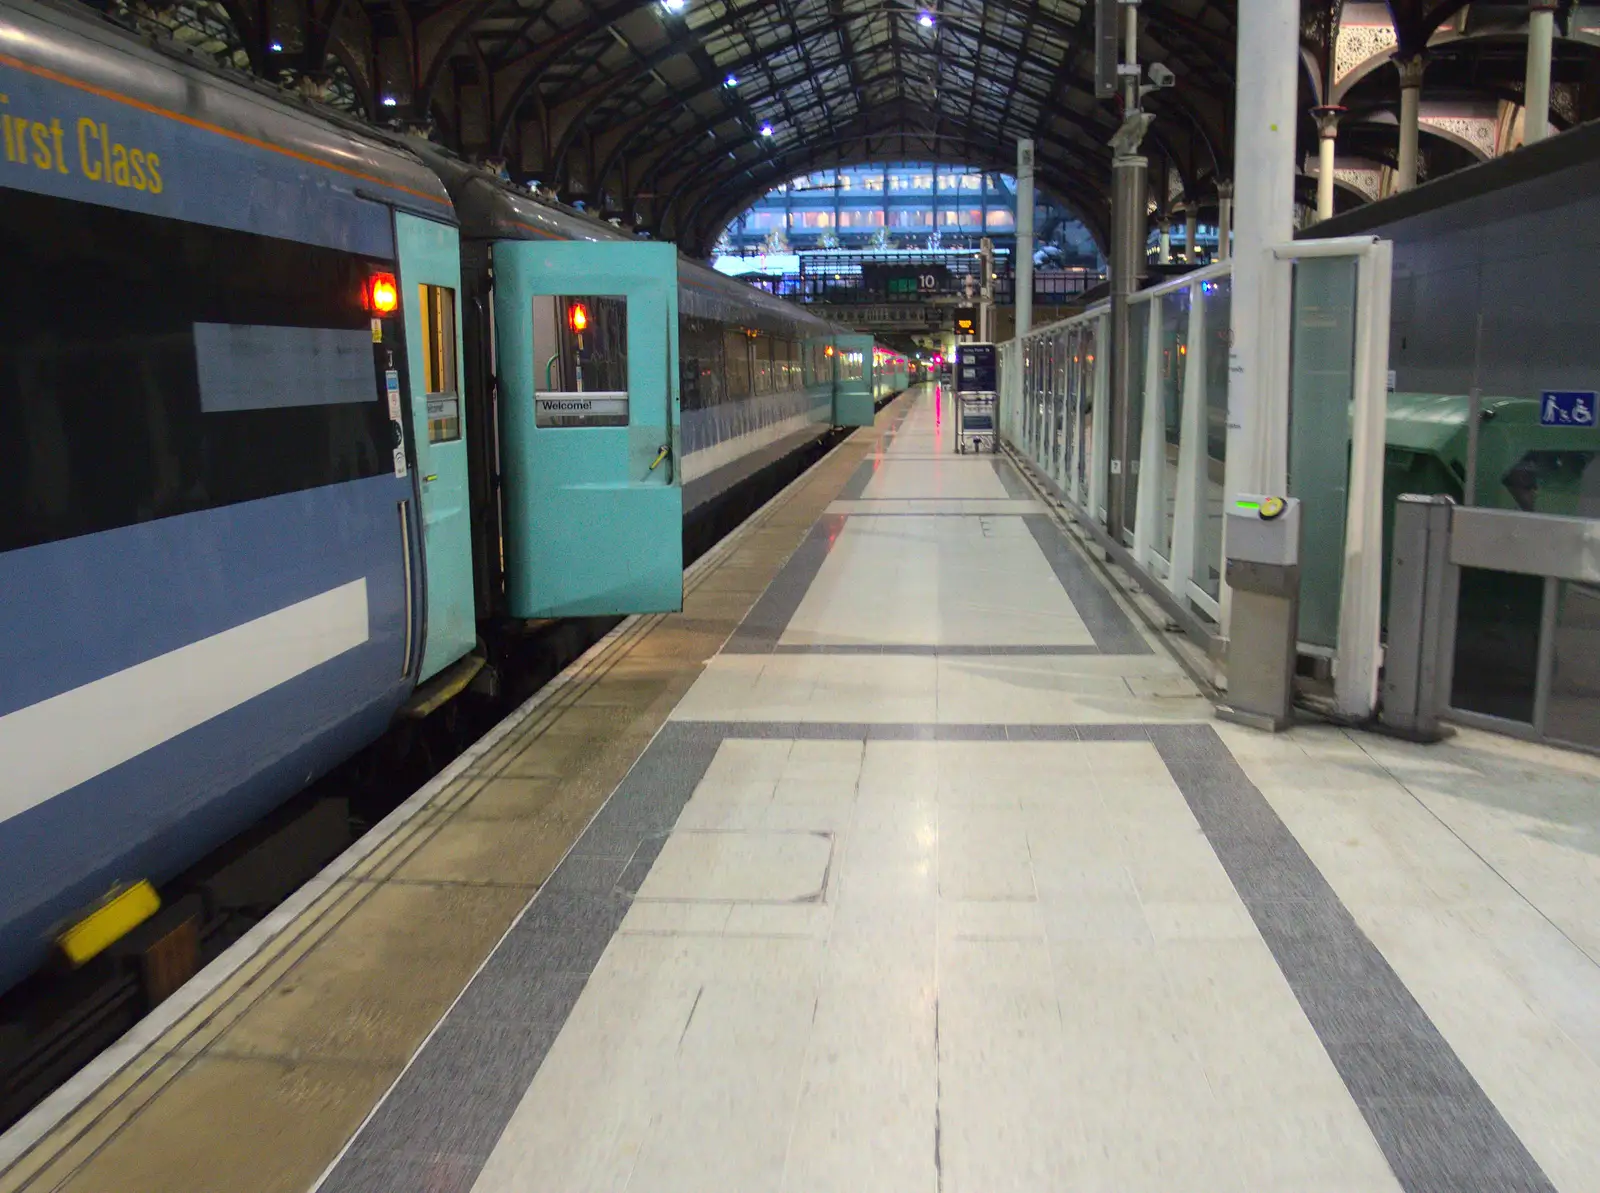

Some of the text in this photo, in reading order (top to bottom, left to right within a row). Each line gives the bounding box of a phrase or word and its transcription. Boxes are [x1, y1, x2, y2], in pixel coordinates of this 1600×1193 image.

[0, 92, 163, 194] irst Class
[918, 274, 935, 289] 10
[542, 401, 592, 410] Welcome!
